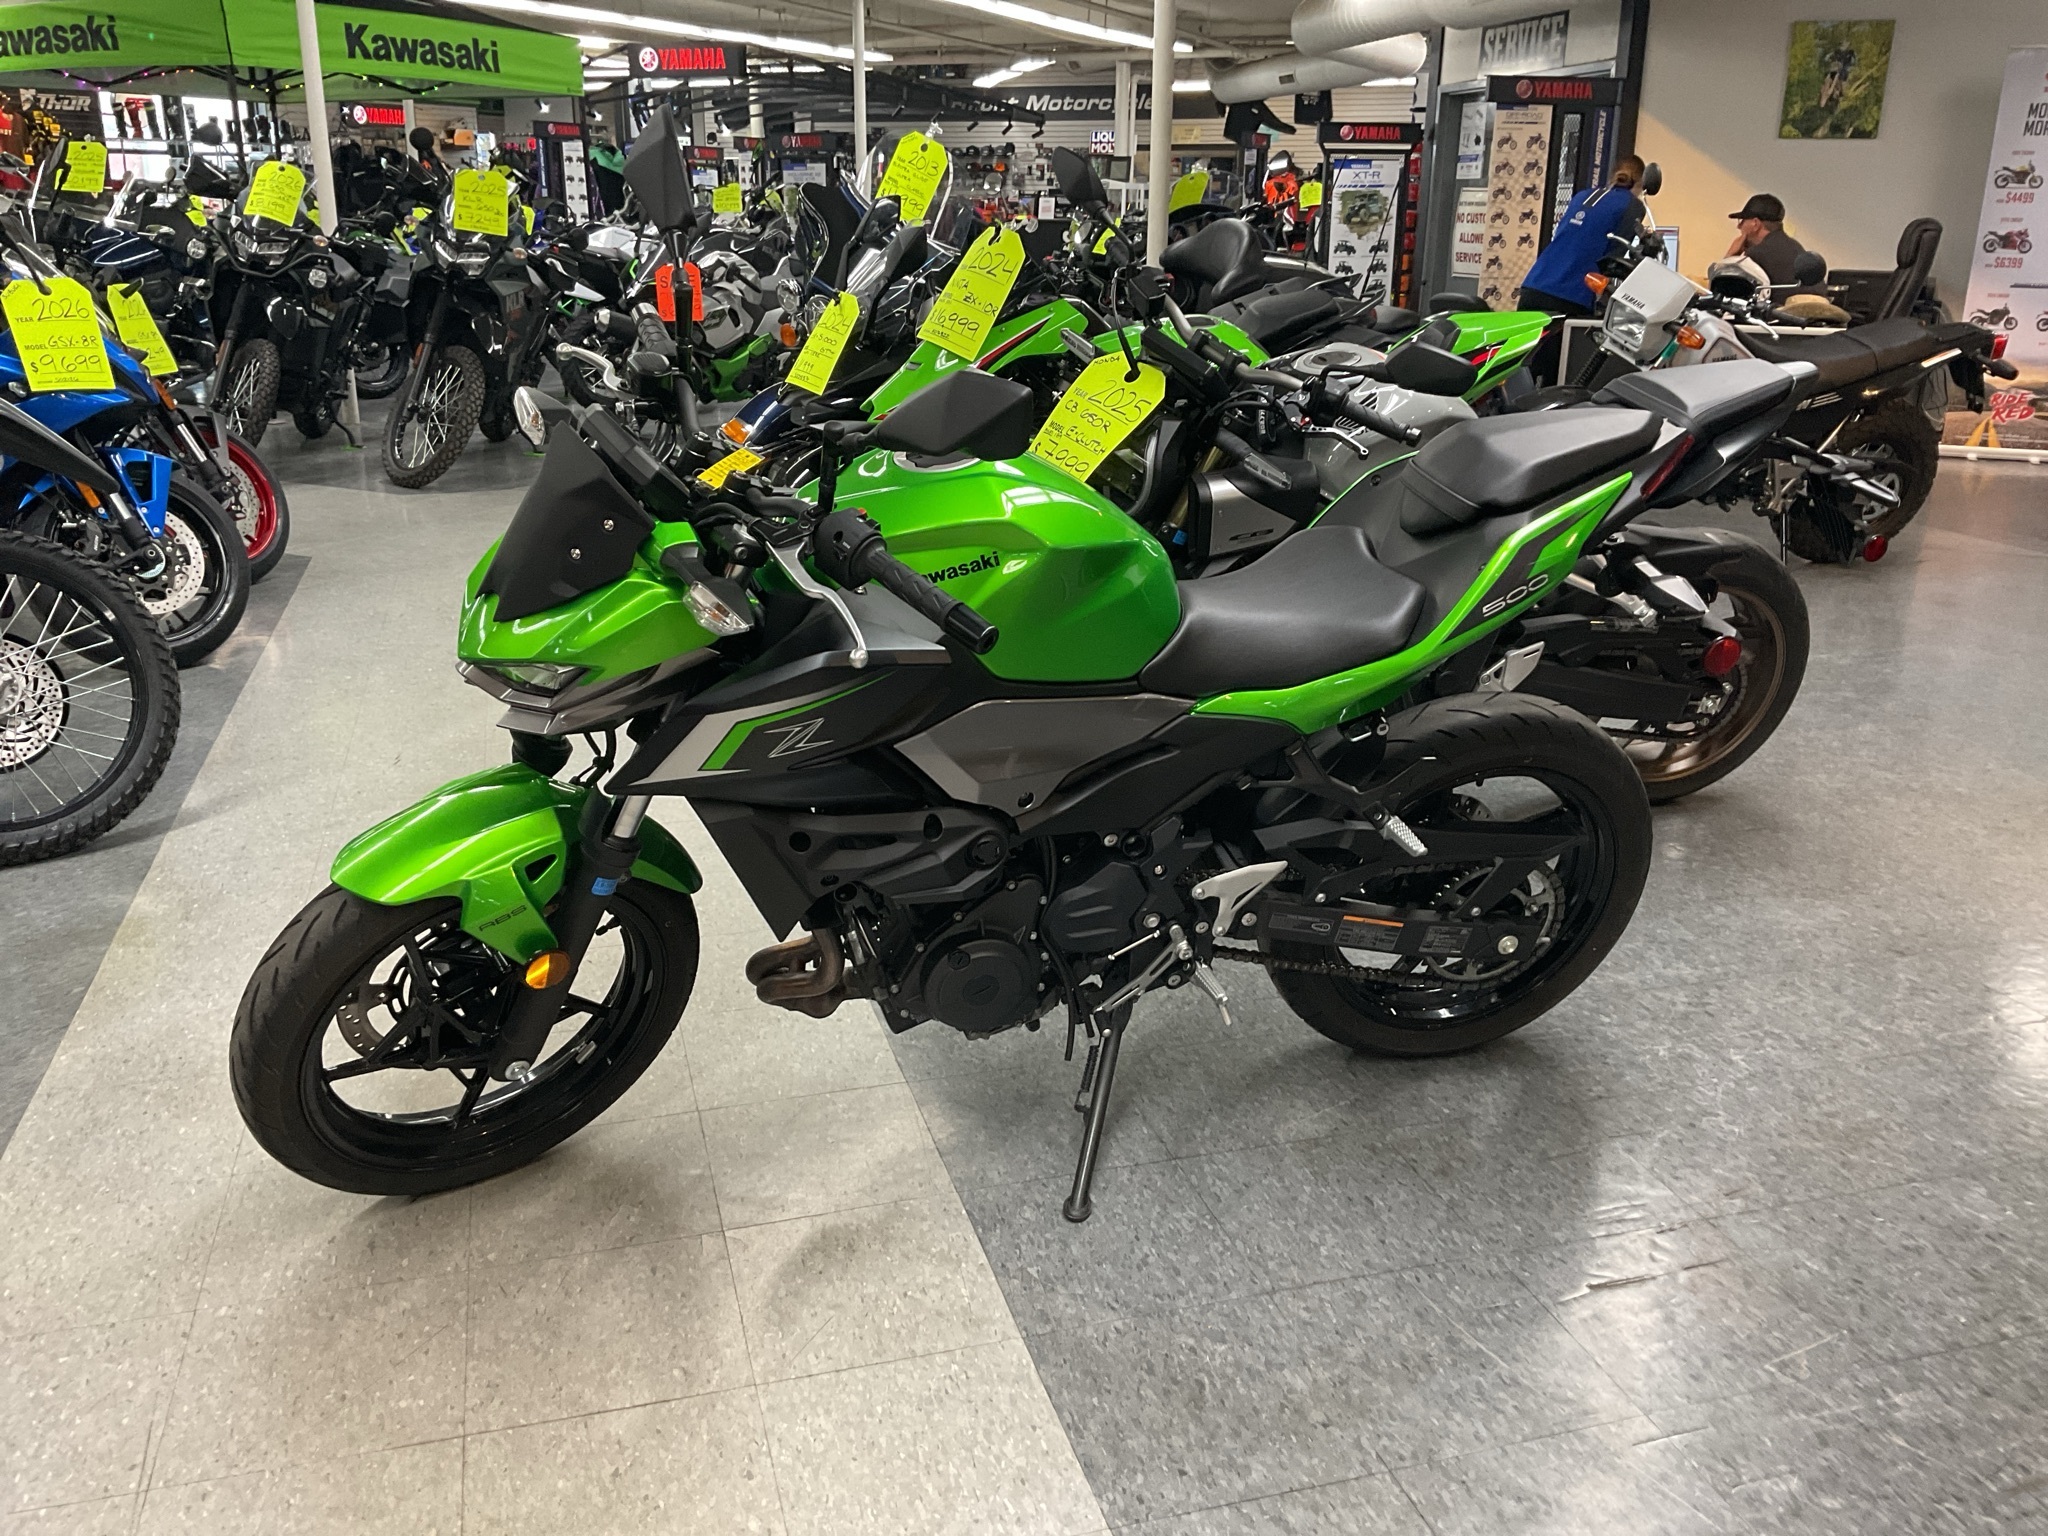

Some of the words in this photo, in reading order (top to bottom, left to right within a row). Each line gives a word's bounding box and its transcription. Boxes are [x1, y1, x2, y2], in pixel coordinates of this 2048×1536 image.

[344, 22, 501, 73] Kawasaki
[1483, 14, 1565, 68] SERVICE
[659, 47, 726, 70] YAMAHA
[1535, 81, 1593, 99] YAMAHA
[37, 93, 91, 111] THOR
[1026, 93, 1152, 114] Motorcle
[1354, 126, 1400, 140] YAMAHA
[907, 151, 940, 177] 2013
[1353, 171, 1381, 179] XT-R
[470, 181, 507, 197] 2025
[2005, 192, 2035, 204] $4499
[1456, 212, 1465, 224] NO
[1459, 232, 1485, 244] ALLOWE
[967, 246, 1019, 285] 2024
[1455, 251, 1482, 264] SERVICE
[1994, 257, 2024, 269] $6399
[32, 298, 90, 321] 2026
[1620, 292, 1646, 310] YAMAHA
[48, 335, 99, 349] GSX-8R
[1092, 355, 1121, 366] HONDA
[1065, 399, 1079, 414] CB
[1073, 386, 1089, 400] YEAR
[1087, 379, 1152, 423] 2025
[1989, 391, 2033, 406] RIDE
[1991, 405, 2035, 424] RED
[1482, 573, 1549, 618] 500
